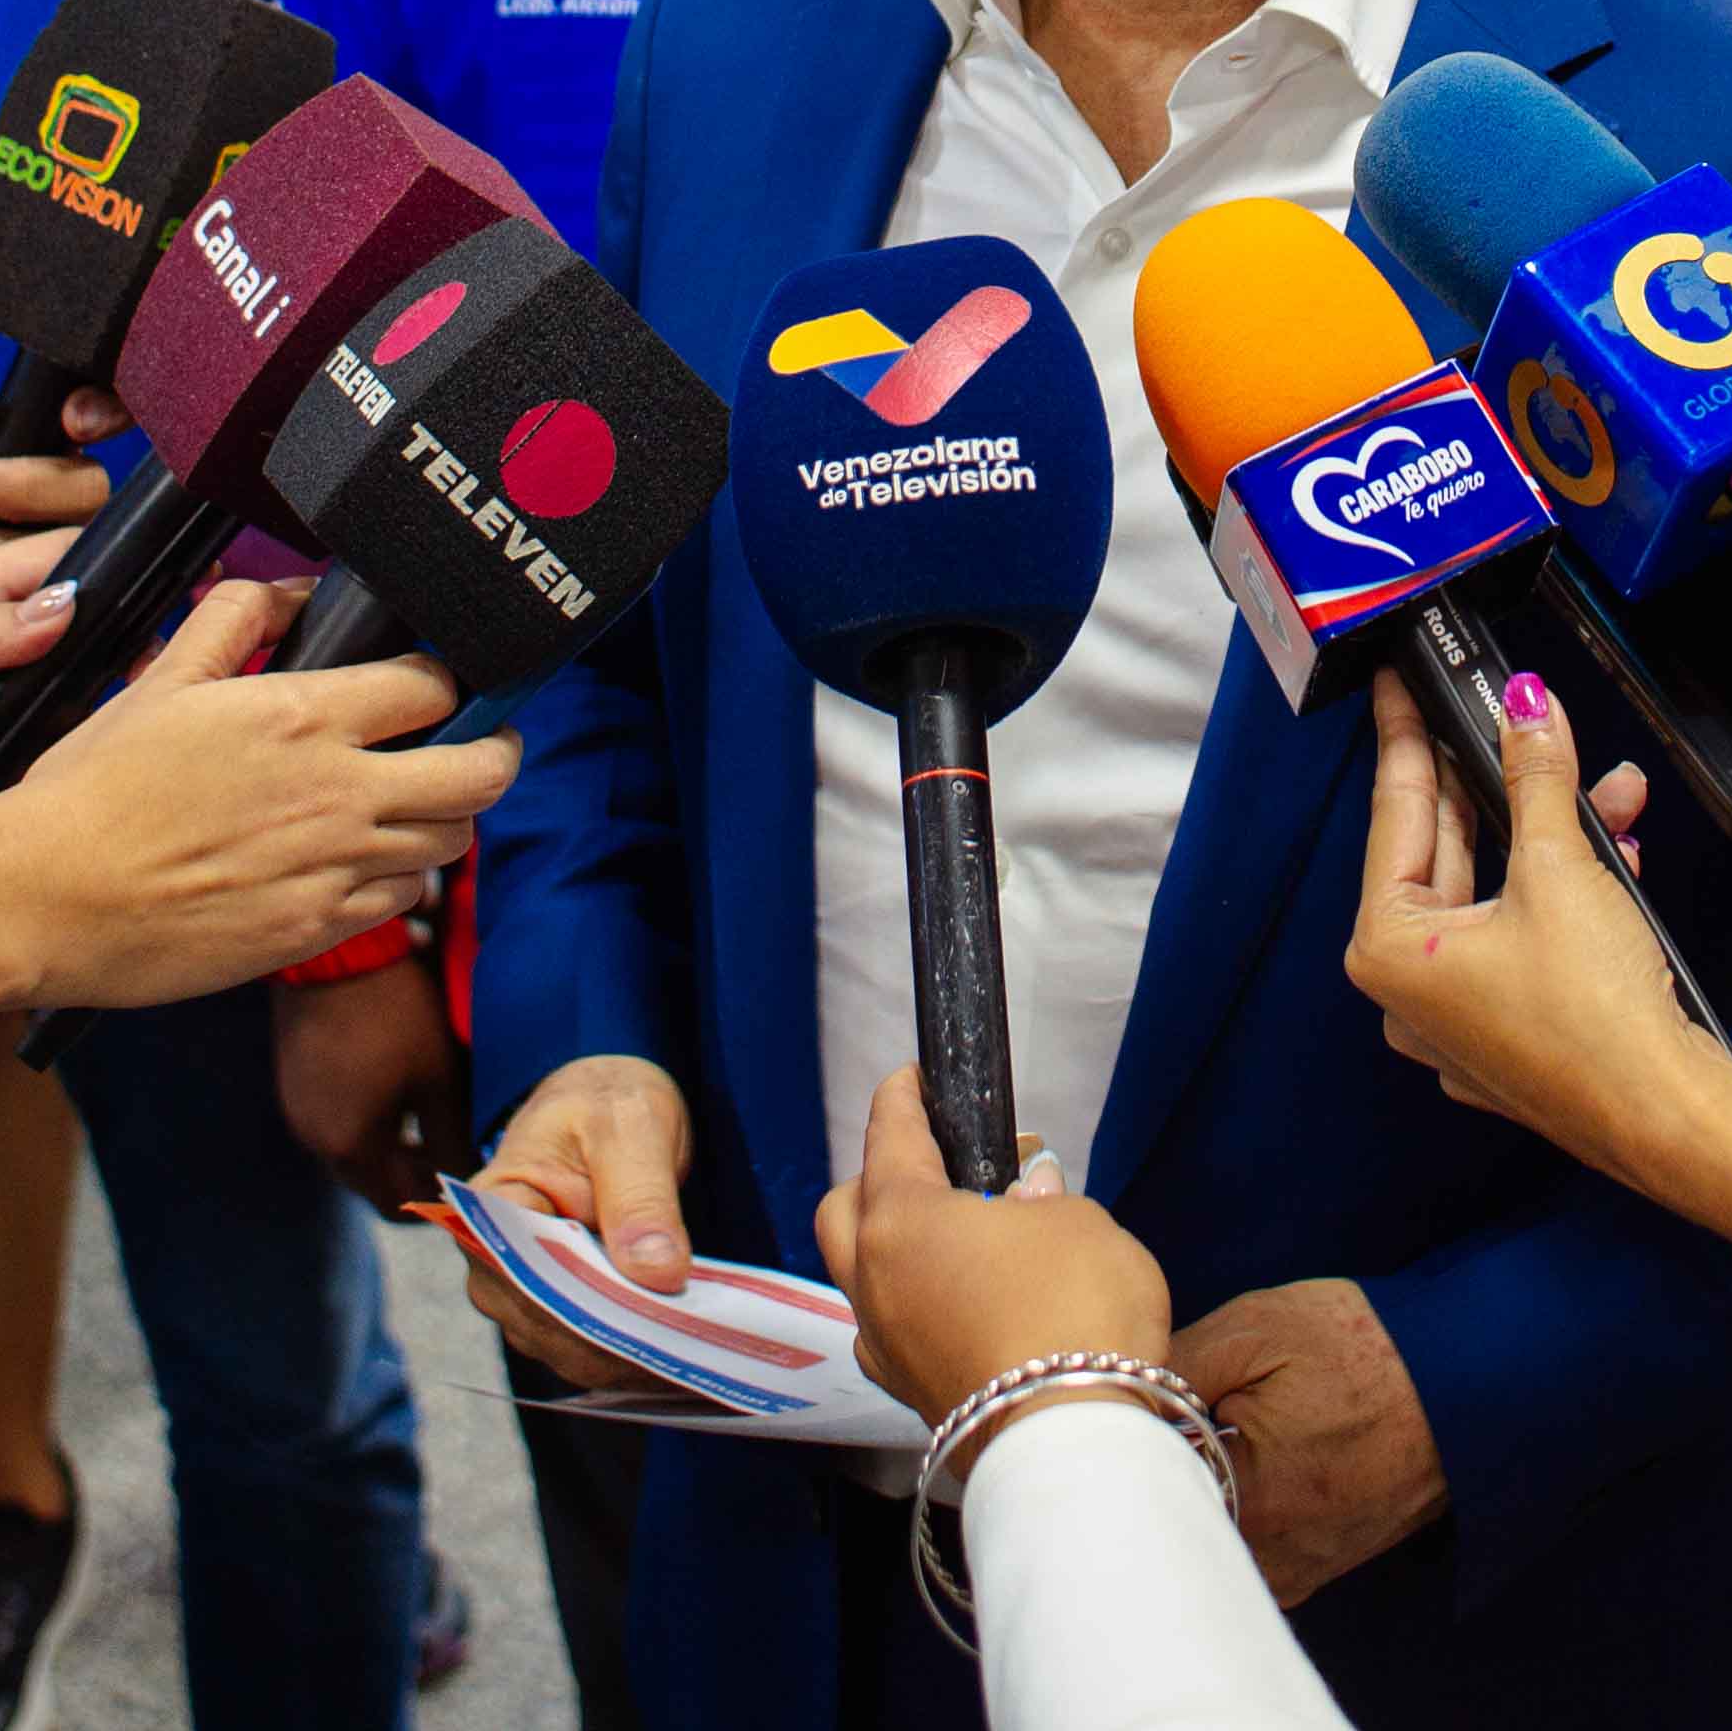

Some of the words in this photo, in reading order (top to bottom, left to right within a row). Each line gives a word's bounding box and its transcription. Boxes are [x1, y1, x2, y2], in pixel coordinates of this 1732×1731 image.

[192, 198, 278, 321] Canal
[324, 342, 398, 428] TELEVEN
[798, 435, 1020, 490] Venezolana
[820, 488, 847, 509] de
[847, 459, 1037, 510] Televisión
[1338, 439, 1474, 525] CARABOBO
[1400, 496, 1425, 524] Te
[1426, 470, 1486, 519] quiero
[400, 420, 597, 621] TELEVEN
[1423, 605, 1466, 666] RoHS
